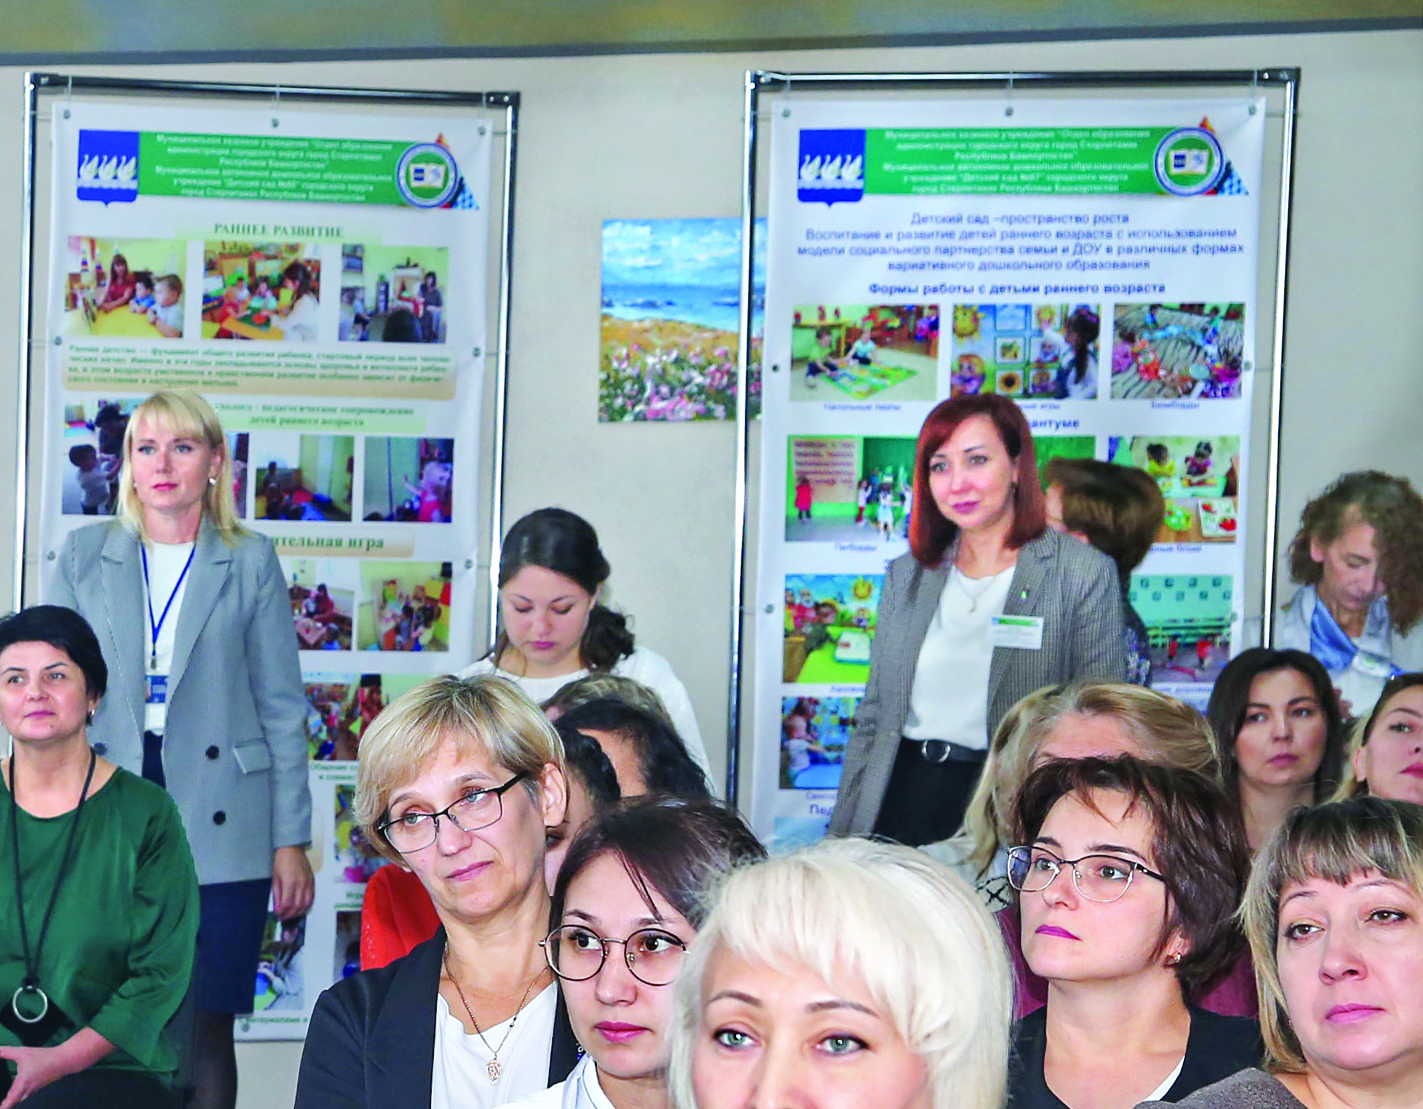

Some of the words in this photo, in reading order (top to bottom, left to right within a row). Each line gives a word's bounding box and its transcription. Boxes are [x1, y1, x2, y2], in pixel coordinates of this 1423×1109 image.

[911, 214, 963, 225] Детский
[966, 214, 989, 225] сад
[994, 214, 1089, 225] –пространство
[1092, 213, 1129, 225] роста
[214, 222, 268, 235] РАННЕЕ
[273, 224, 343, 237] РАЗВИТИЕ
[805, 230, 881, 241] Воспитание
[884, 230, 892, 240] и
[896, 230, 955, 241] развитие
[958, 229, 996, 240] детей
[1000, 230, 1051, 240] раннего
[1054, 229, 1112, 240] возраста
[1116, 229, 1123, 240] с
[1126, 228, 1236, 239] использованием
[797, 246, 845, 256] модели
[848, 246, 930, 256] социального
[933, 245, 1014, 256] партнерства
[1017, 245, 1057, 255] семьи
[1061, 246, 1069, 255] и
[1072, 241, 1101, 256] ДОУ
[1104, 245, 1112, 255] в
[1116, 244, 1187, 255] различных
[1191, 244, 1243, 255] формах
[887, 260, 974, 271] вариативного
[978, 260, 1062, 271] дошкольного
[1065, 259, 1149, 271] образования
[868, 284, 918, 295] Формы
[922, 284, 973, 295] работы
[978, 284, 985, 295] с
[989, 284, 1039, 294] детьми
[1043, 284, 1098, 294] раннего
[1103, 283, 1165, 294] возраста
